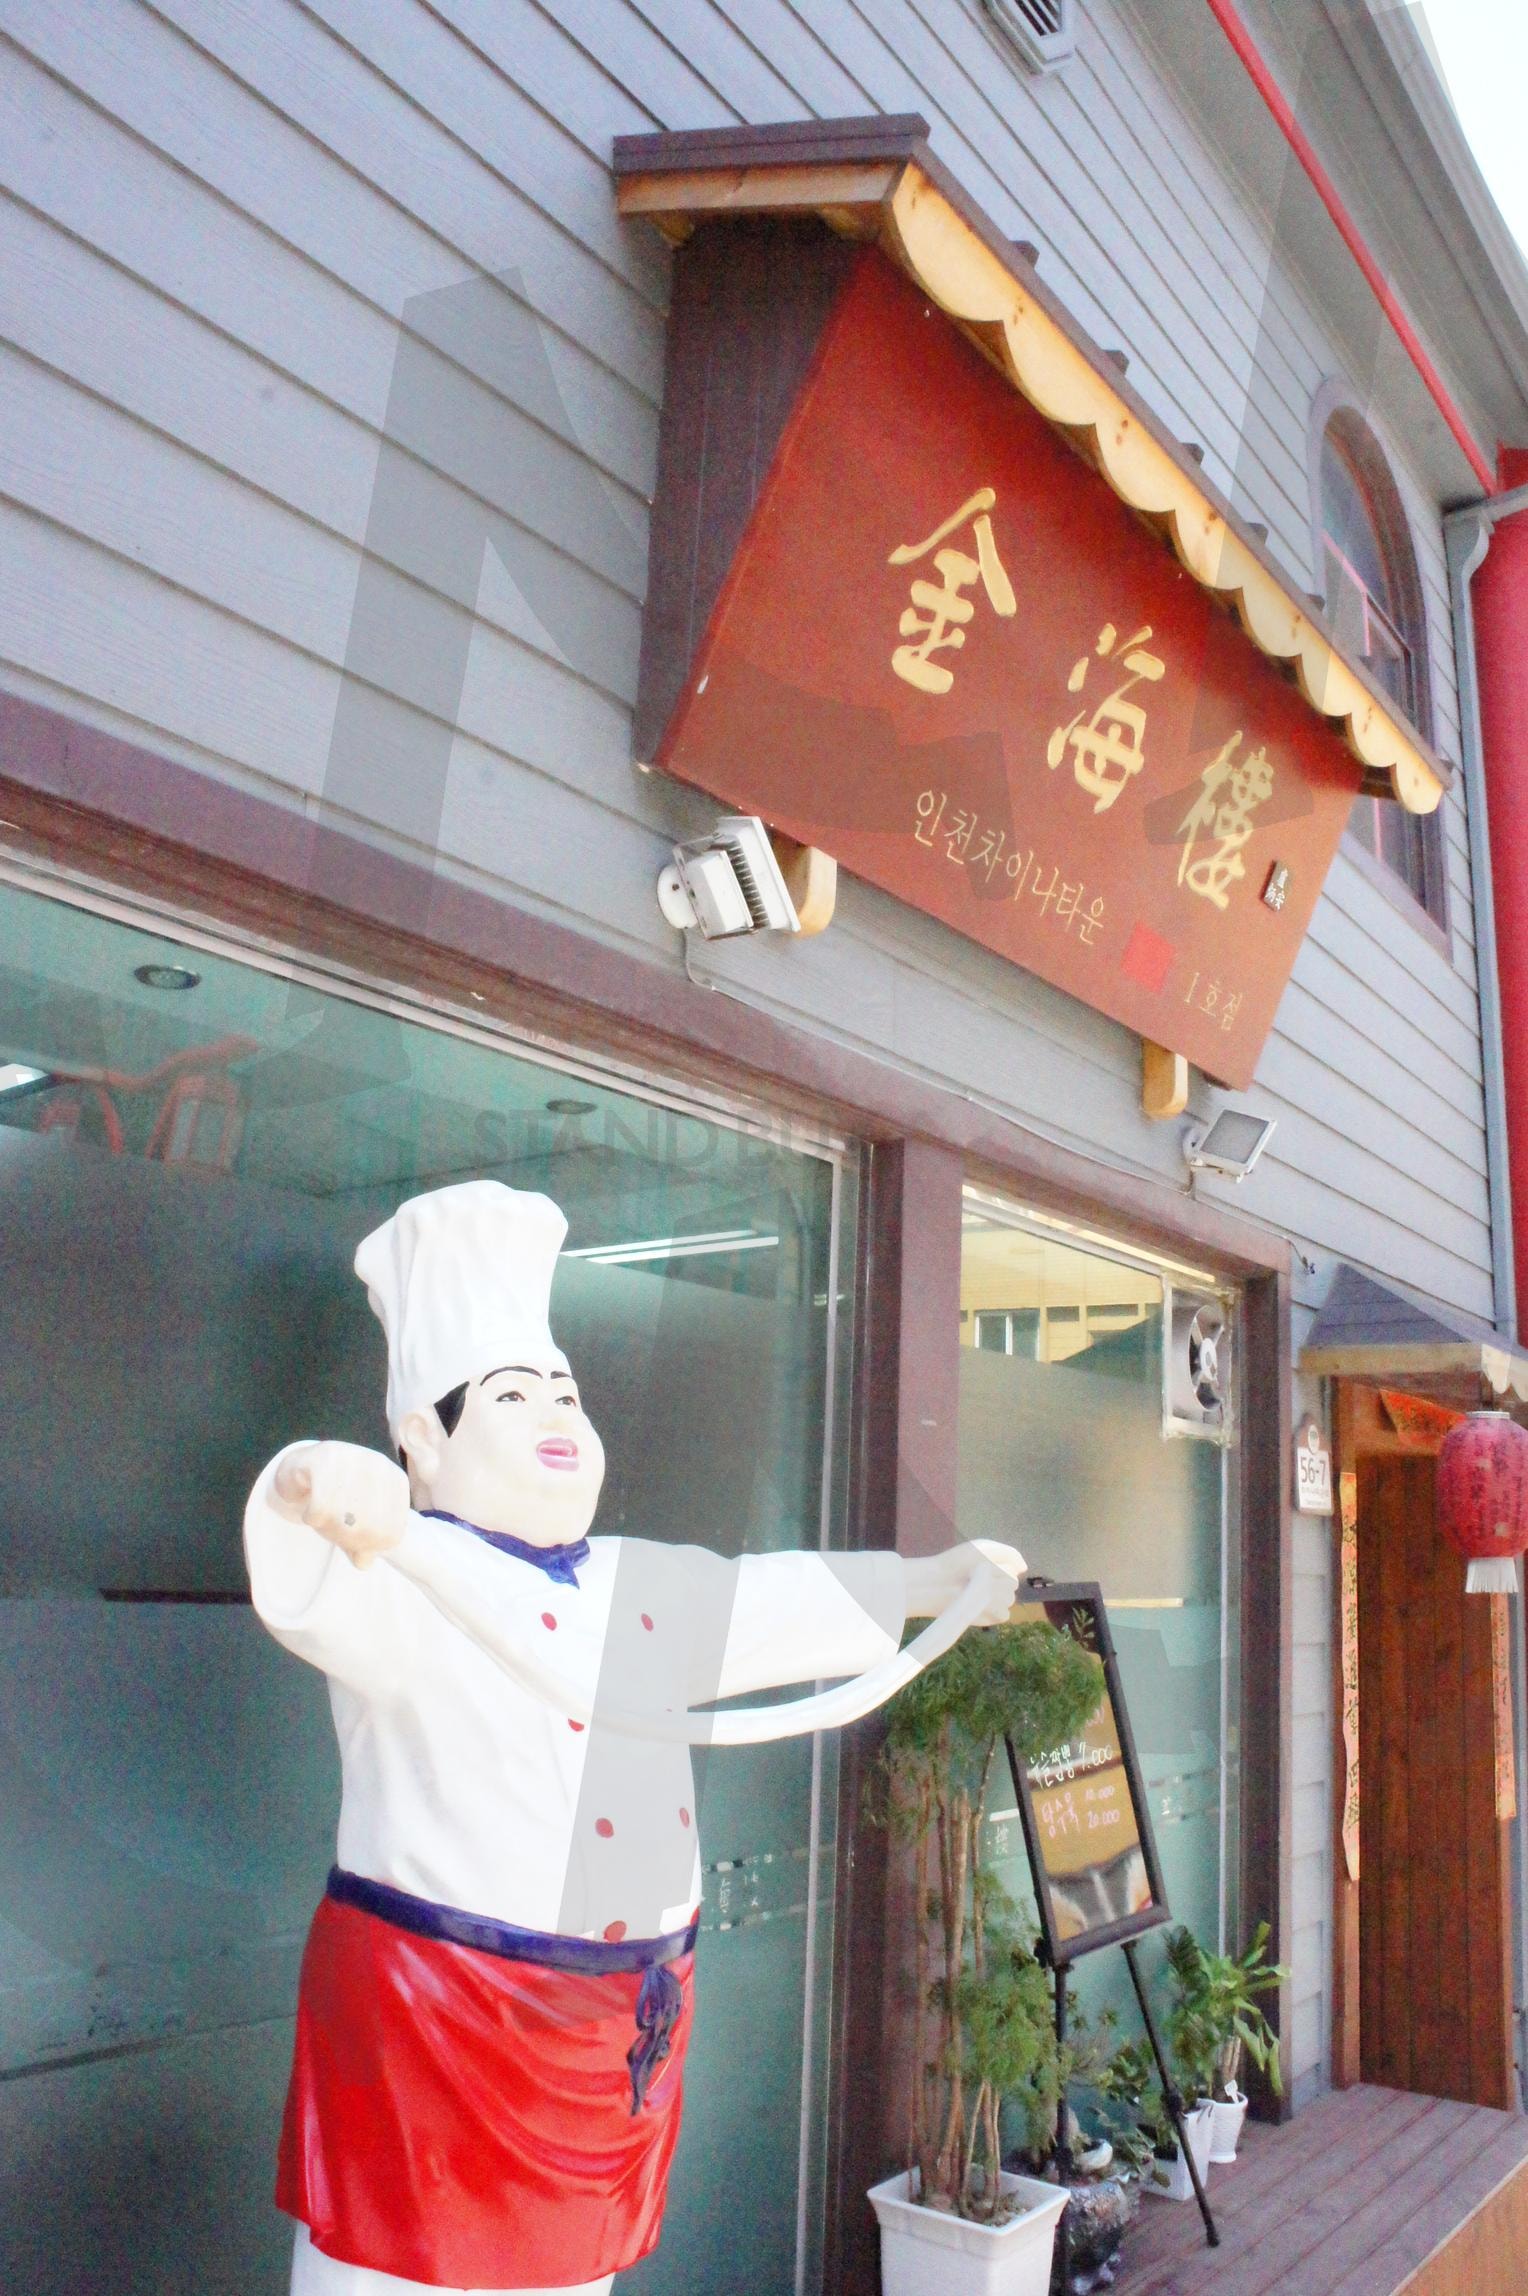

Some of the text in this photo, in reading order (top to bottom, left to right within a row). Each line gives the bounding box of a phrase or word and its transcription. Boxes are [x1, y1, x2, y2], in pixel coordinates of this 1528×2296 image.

[888, 487, 1273, 909] 金海樓
[914, 790, 1105, 945] 인천차이나타운
[1300, 1456, 1326, 1486] 56-7
